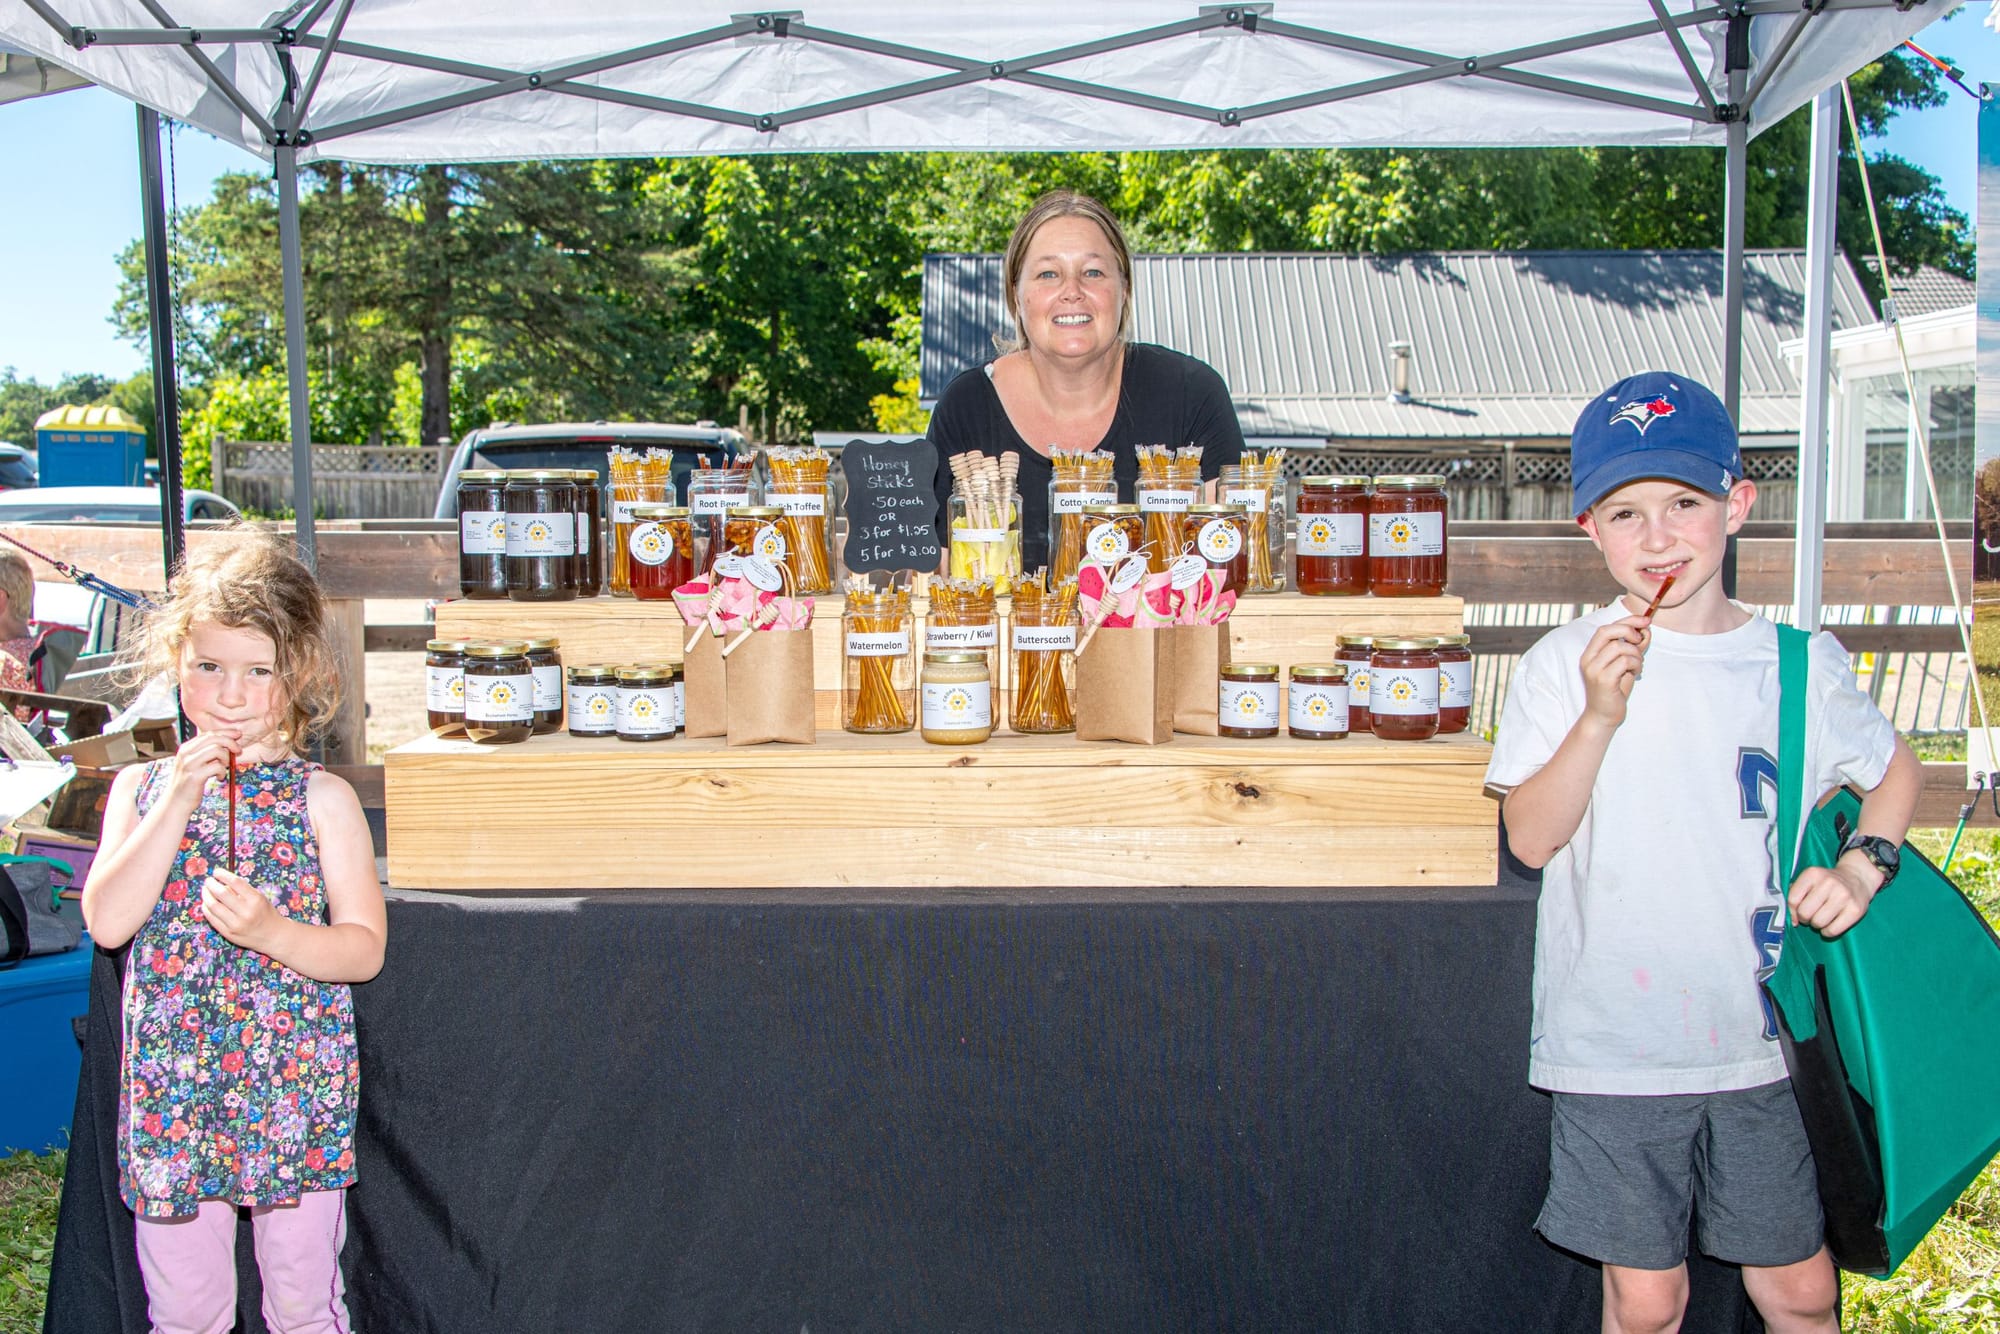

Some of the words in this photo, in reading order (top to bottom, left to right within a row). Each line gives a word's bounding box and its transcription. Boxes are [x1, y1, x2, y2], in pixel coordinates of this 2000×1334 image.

[862, 454, 910, 476] Honey
[867, 474, 914, 489] Sticks
[699, 500, 718, 508] Root
[871, 496, 896, 509] .50
[899, 496, 924, 507] each
[1060, 498, 1088, 506] Cotton
[1146, 496, 1189, 505] Cinnamon
[1231, 498, 1257, 507] Apple
[794, 502, 822, 510] Toffee
[878, 512, 896, 522] OR
[872, 525, 892, 539] for
[898, 523, 930, 537] $1.25
[860, 548, 870, 562] 5
[874, 545, 895, 561] for
[901, 543, 937, 557] $2.00
[926, 630, 968, 641] Strawberry
[976, 629, 993, 640] Kiwi
[1017, 634, 1071, 644] Butterscotch
[849, 640, 903, 651] Watermelon
